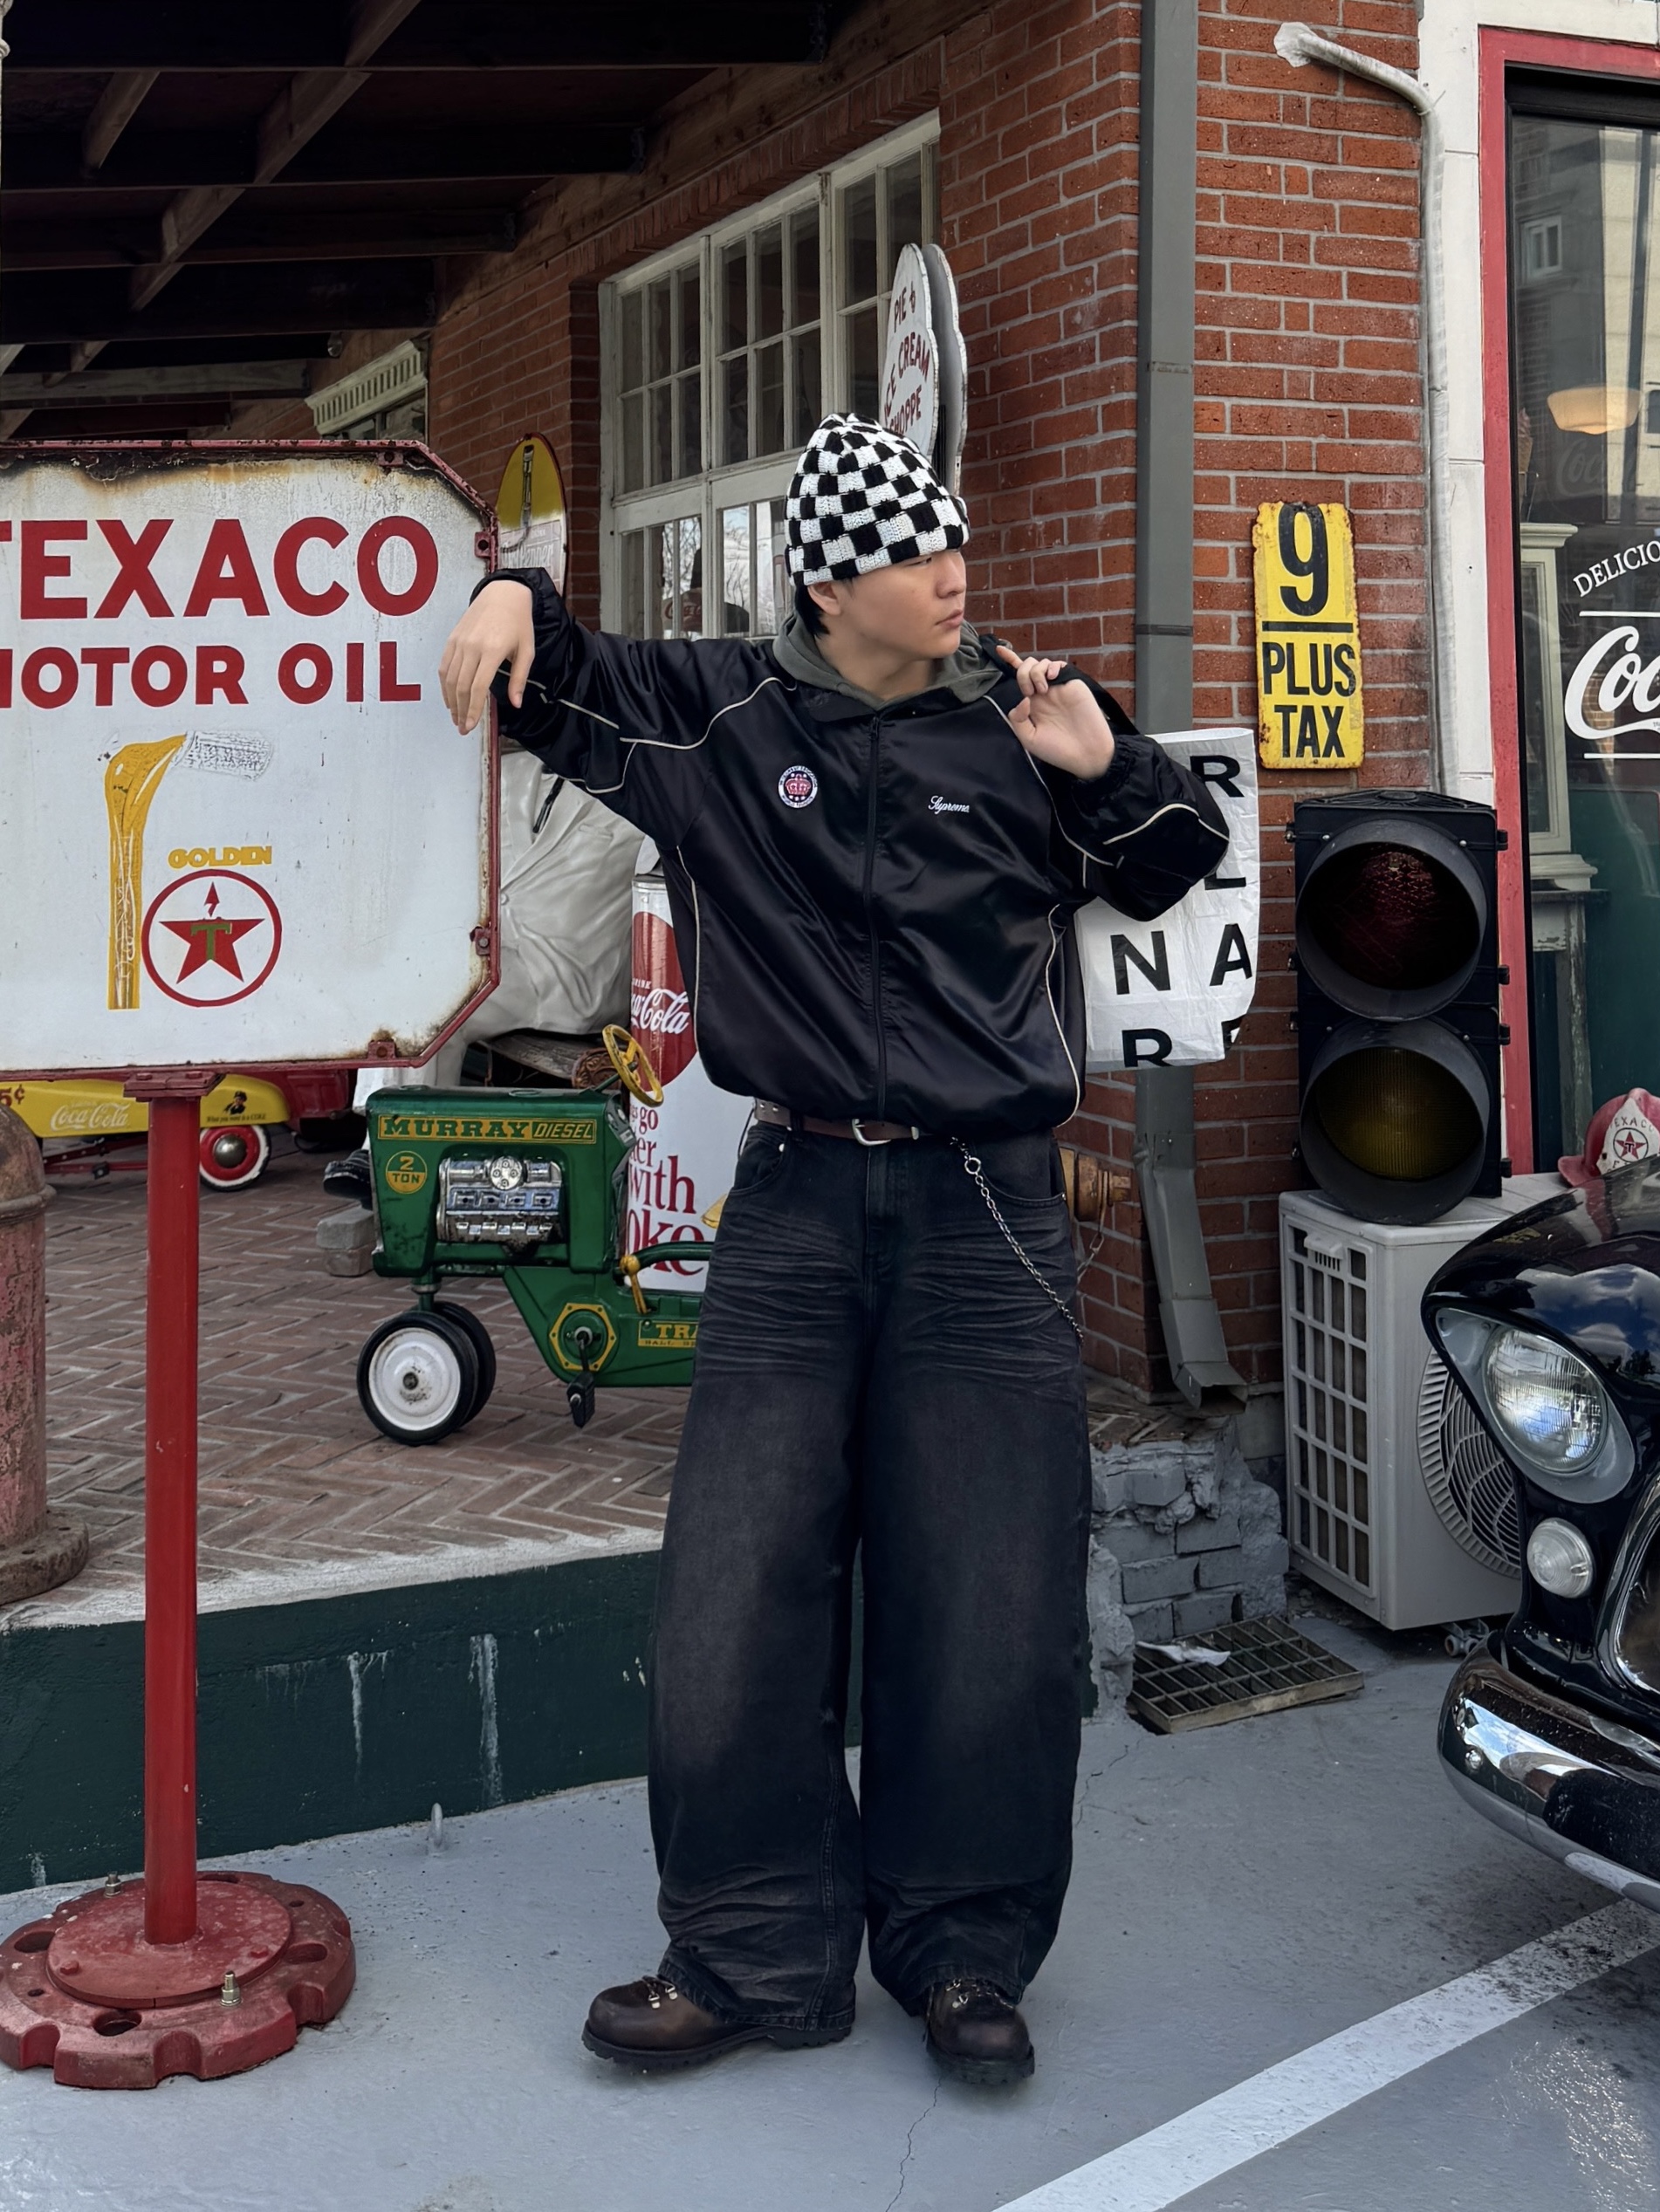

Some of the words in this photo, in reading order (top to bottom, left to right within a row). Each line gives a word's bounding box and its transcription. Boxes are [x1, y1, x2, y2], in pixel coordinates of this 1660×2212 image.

[894, 287, 907, 332] PIE
[898, 332, 929, 382] CREAM
[1279, 503, 1329, 616] 9
[0, 644, 249, 709] OTOR
[278, 641, 422, 704] OIL
[1262, 642, 1356, 696] PLUS
[1274, 705, 1345, 757] TAX
[929, 795, 970, 814] Supreme
[384, 1119, 529, 1139] MURRAY
[533, 1123, 594, 1139] DIESEL
[639, 1106, 659, 1134] go
[392, 1173, 420, 1184] TON
[399, 1156, 414, 1170] 2
